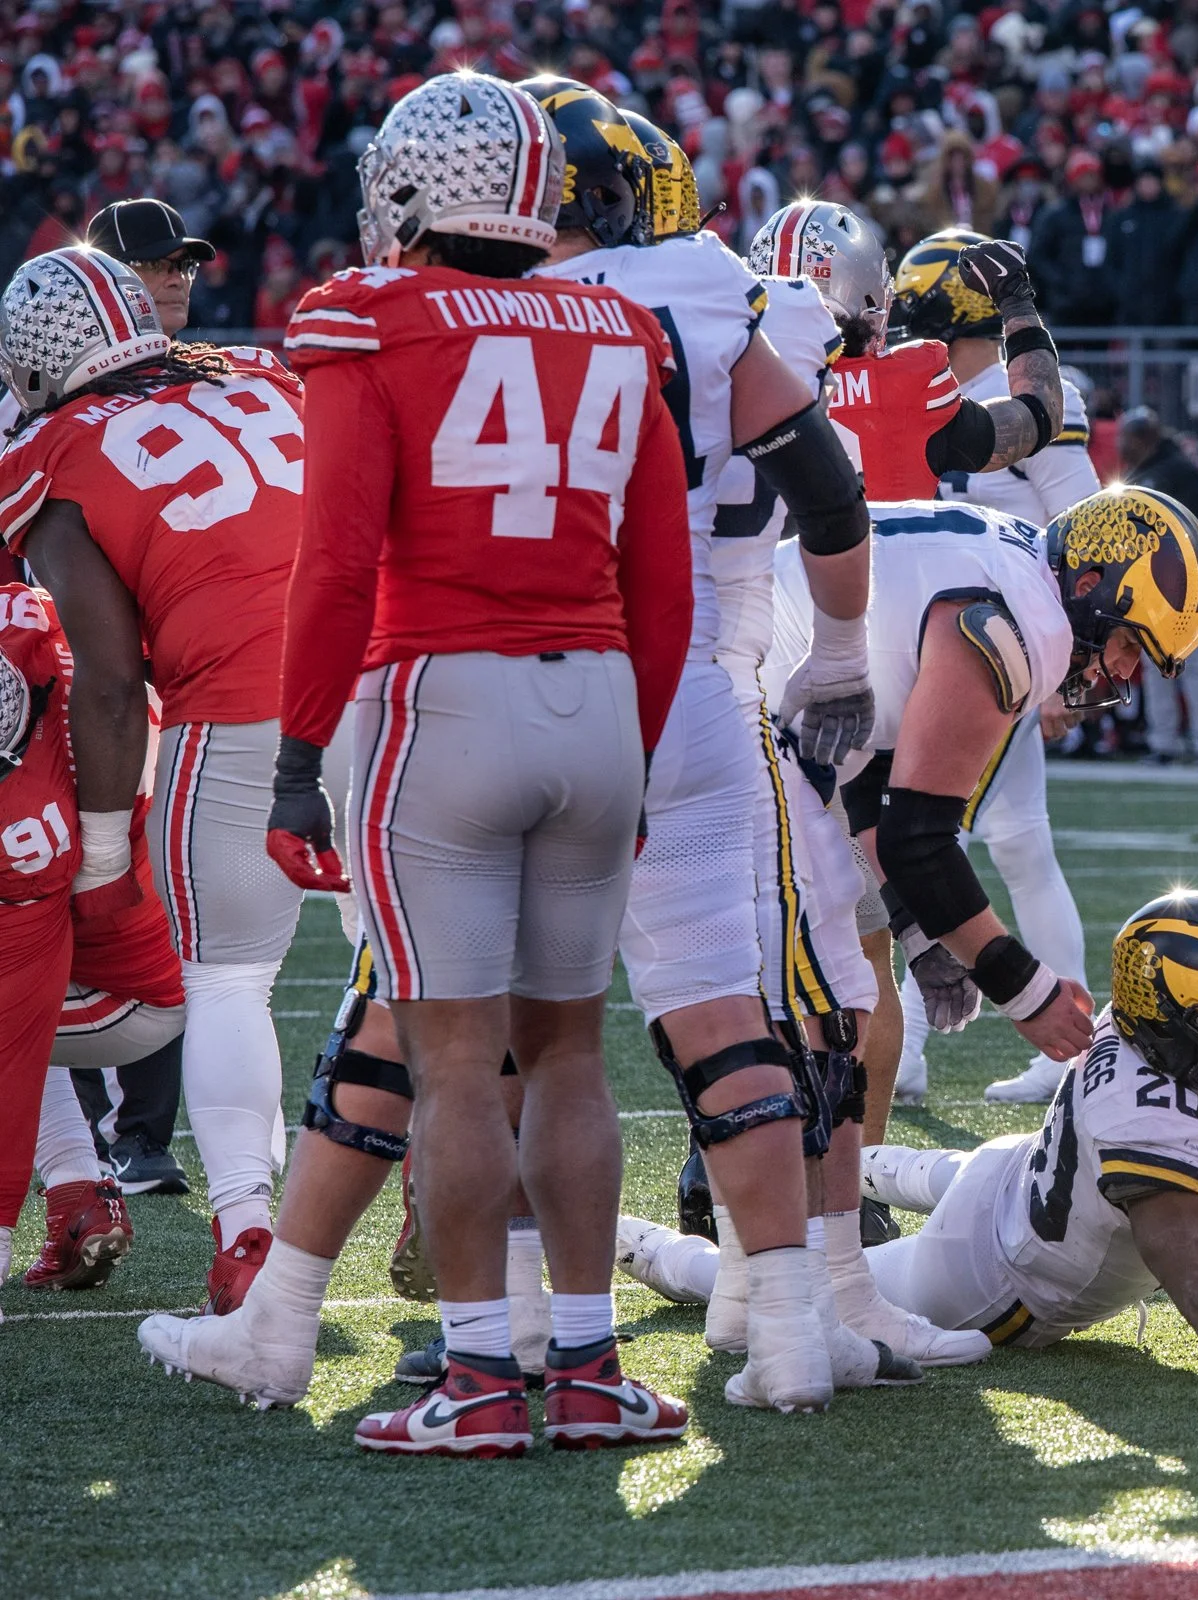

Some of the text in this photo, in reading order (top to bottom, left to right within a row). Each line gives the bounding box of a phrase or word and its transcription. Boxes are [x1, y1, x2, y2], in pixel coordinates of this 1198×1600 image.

[425, 289, 633, 337] TUIMOLOAU
[87, 340, 168, 376] BUCKEYES
[100, 374, 304, 532] 98
[431, 334, 649, 547] 44
[0, 801, 72, 876] 91
[734, 1101, 787, 1123] DONJOY
